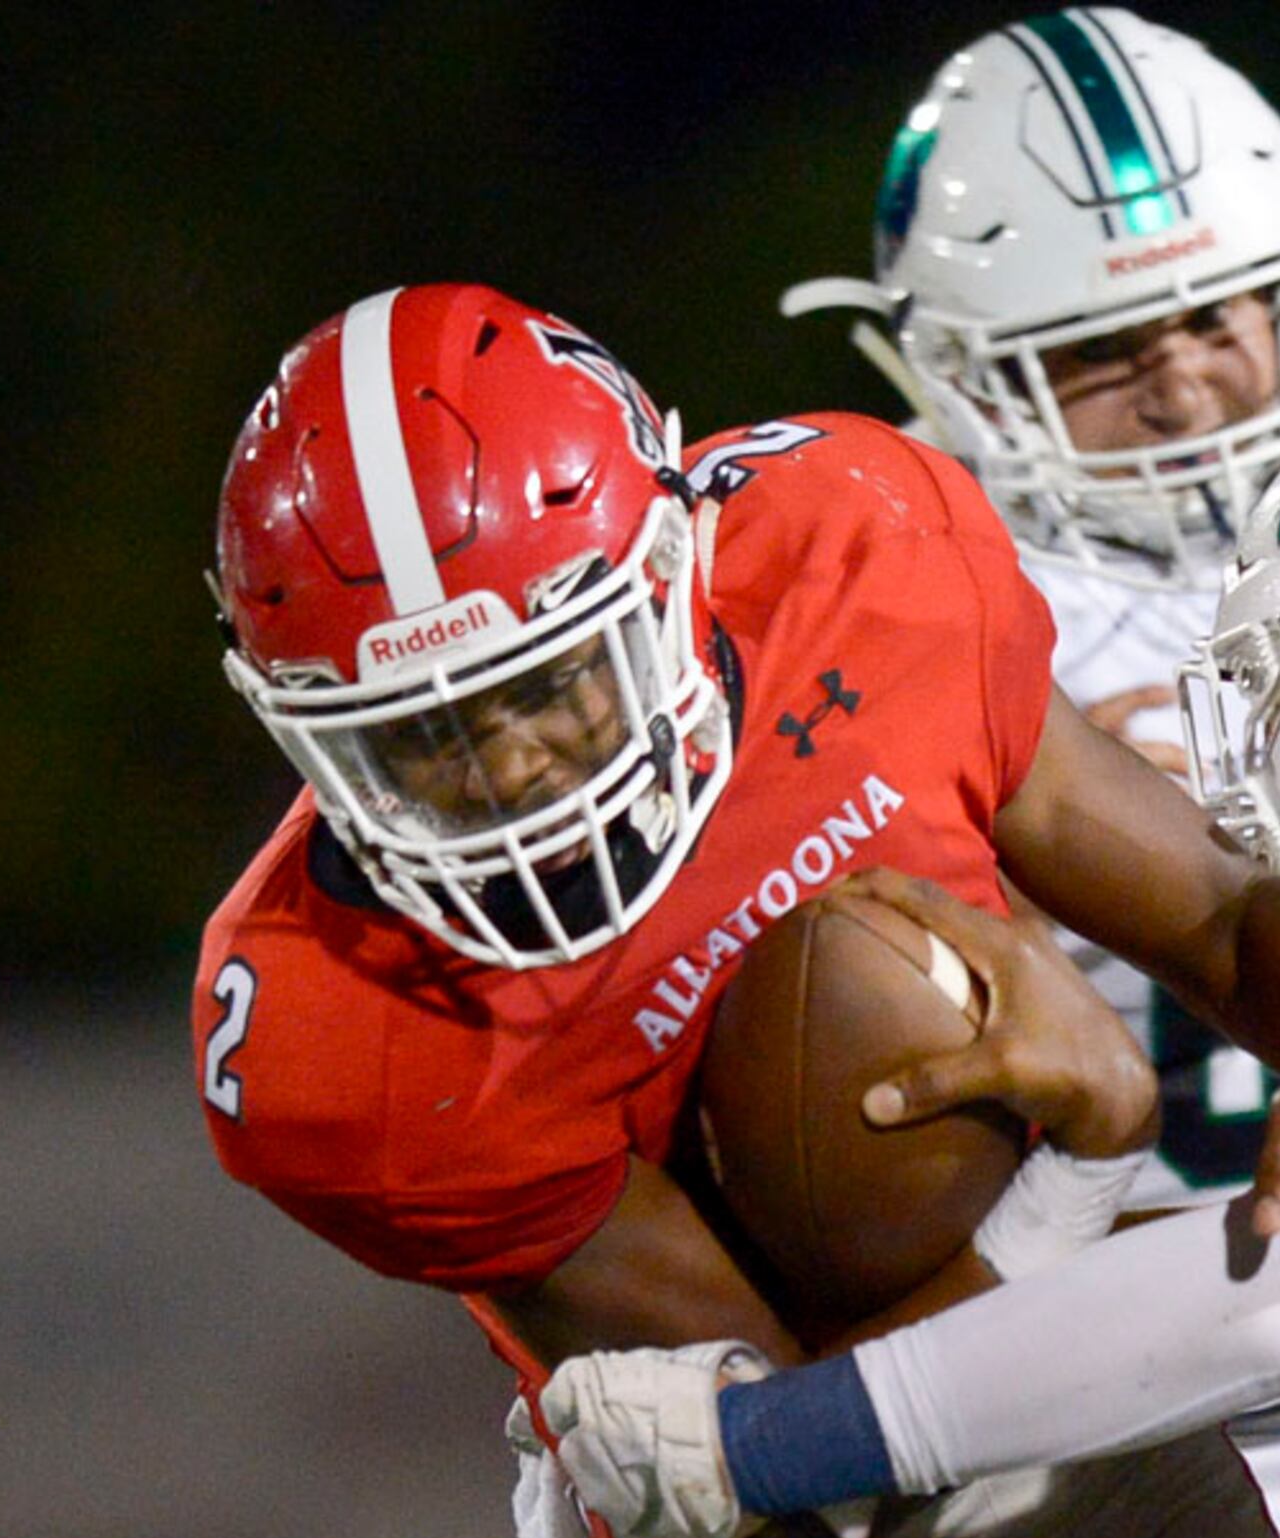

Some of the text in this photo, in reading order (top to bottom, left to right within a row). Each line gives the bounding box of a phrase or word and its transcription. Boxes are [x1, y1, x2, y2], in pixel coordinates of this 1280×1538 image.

[369, 602, 490, 665] Riddell
[632, 773, 905, 1053] ALLATOONA
[203, 955, 258, 1126] 2
